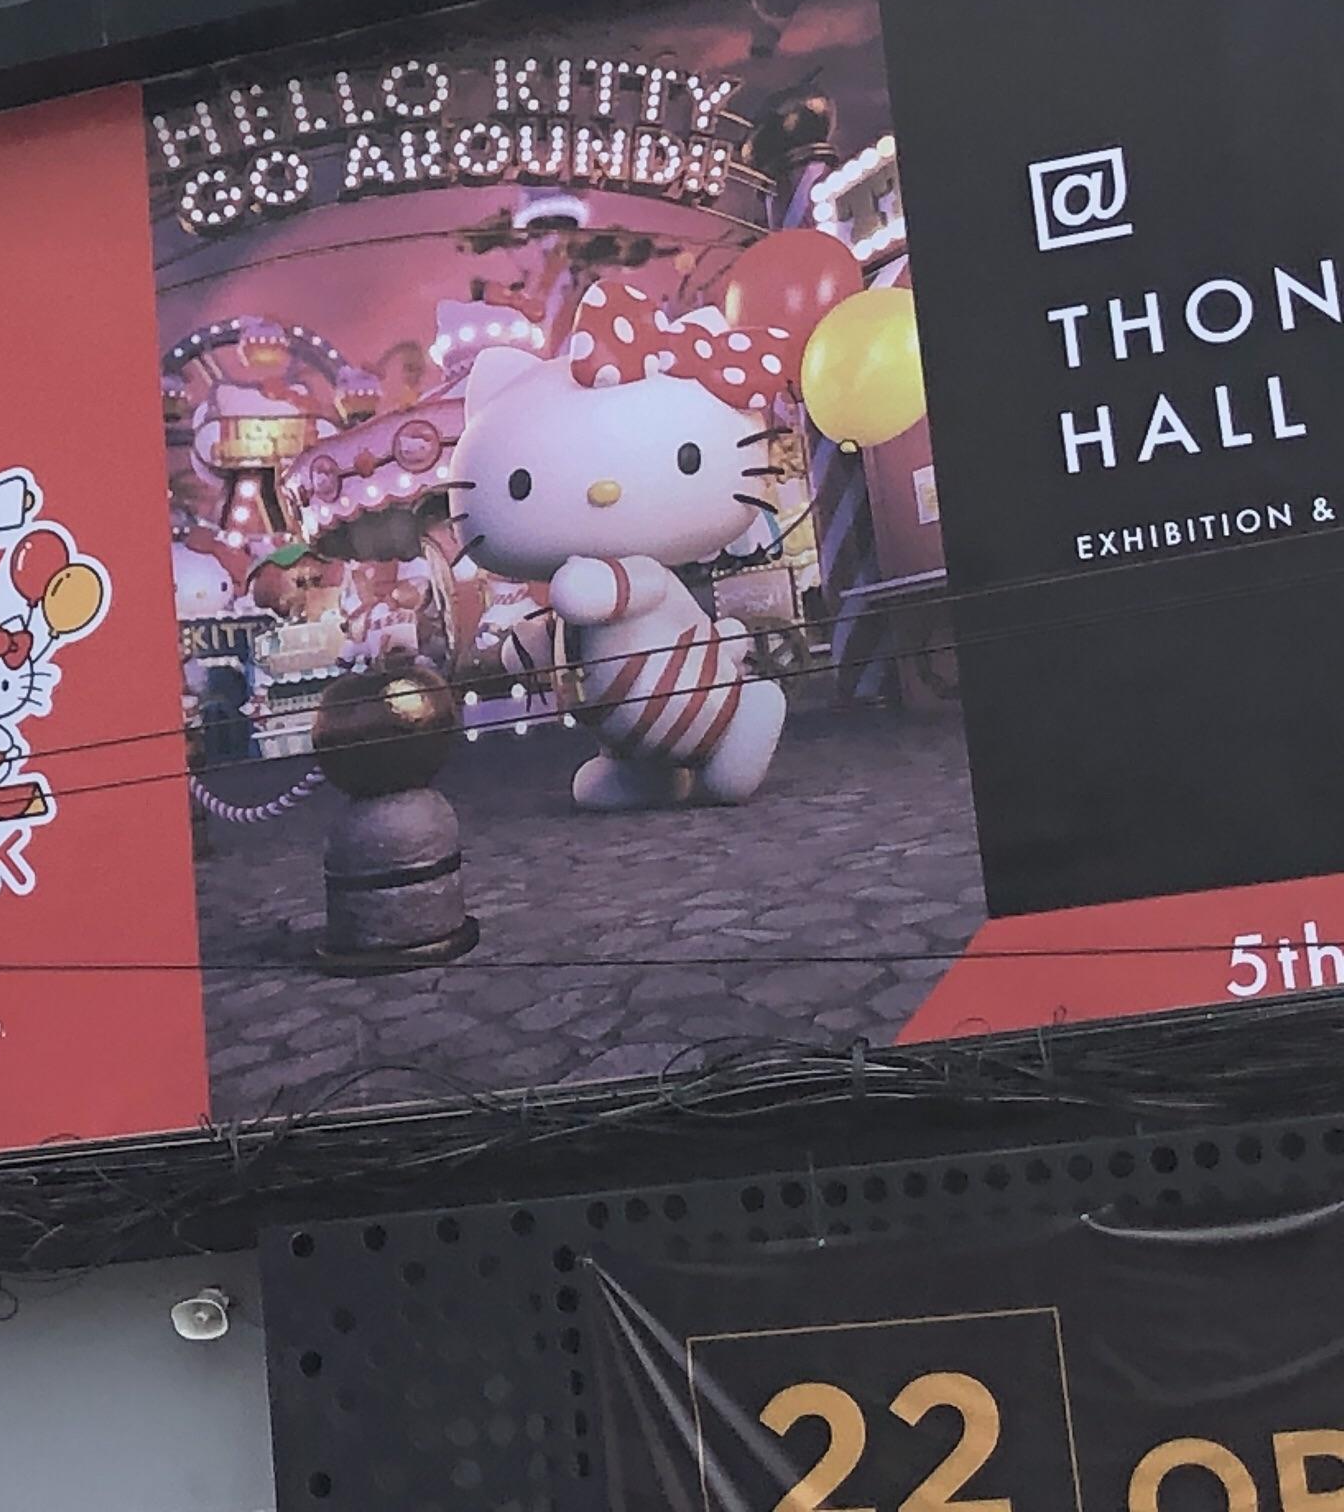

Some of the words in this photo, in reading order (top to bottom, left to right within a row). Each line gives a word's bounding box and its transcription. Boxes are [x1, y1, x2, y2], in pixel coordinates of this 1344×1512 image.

[151, 58, 450, 170] HELLO
[493, 56, 736, 132] KITTY
[179, 148, 311, 228] GO
[1047, 259, 1344, 368] THON
[1060, 376, 1308, 475] HALL
[1076, 501, 1293, 561] EXHIBITION
[1312, 496, 1336, 523] &
[1227, 920, 1344, 997] 5th
[759, 1371, 1012, 1512] 22
